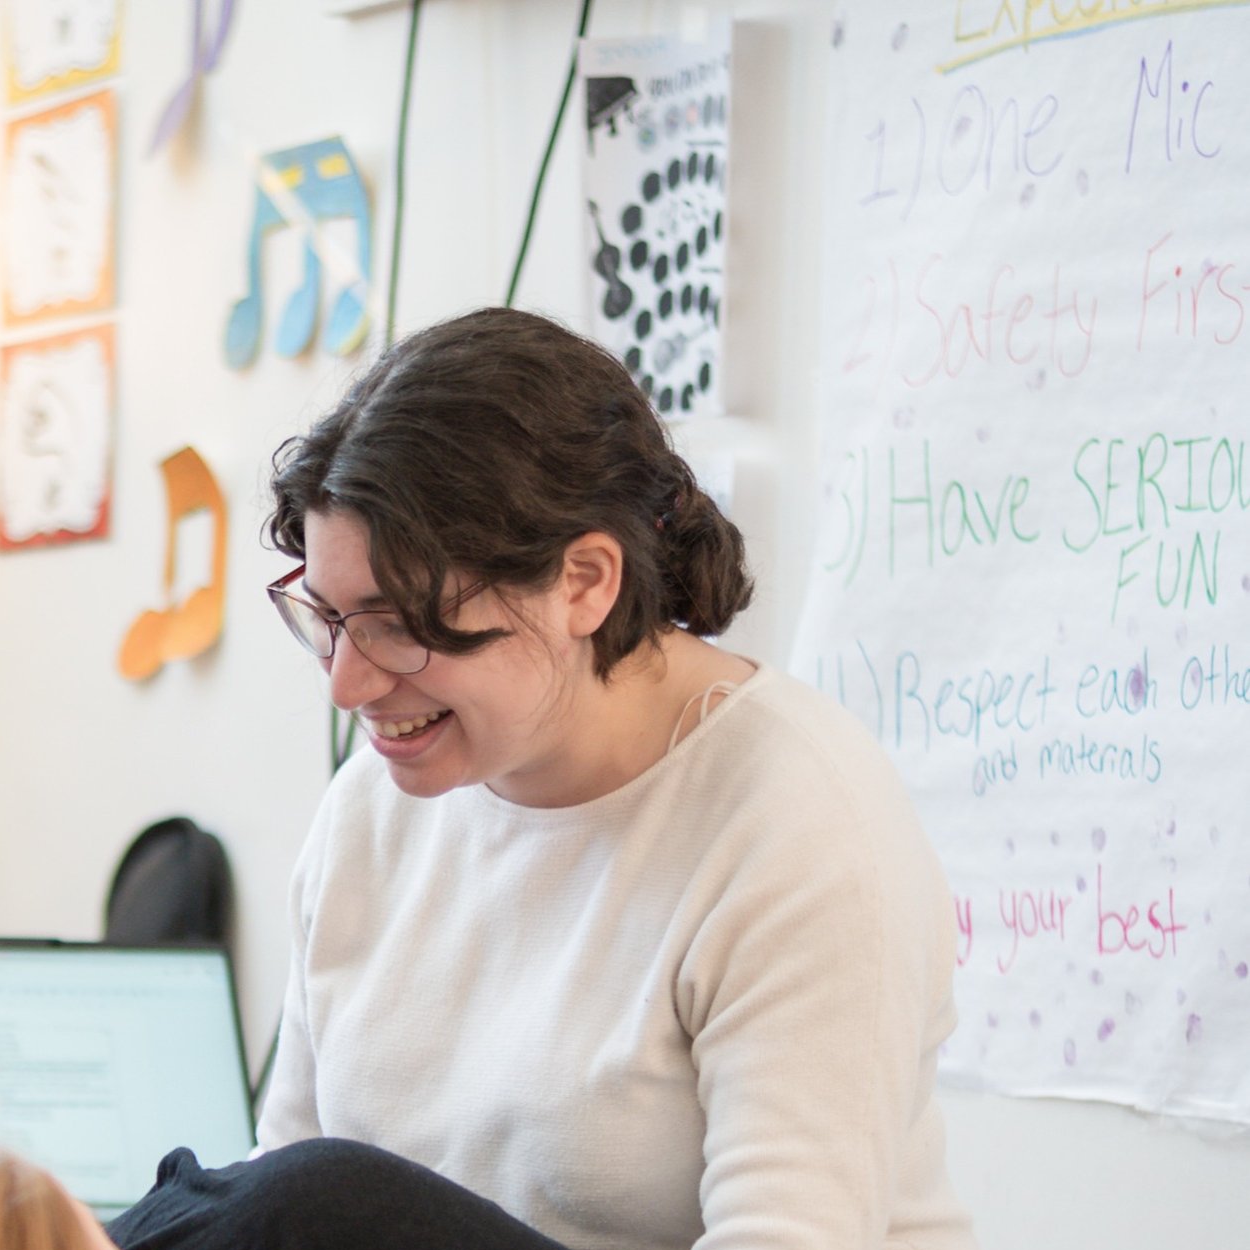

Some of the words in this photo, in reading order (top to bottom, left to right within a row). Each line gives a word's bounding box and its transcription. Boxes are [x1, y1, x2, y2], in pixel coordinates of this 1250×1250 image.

[1126, 40, 1221, 173] Mic
[1137, 229, 1250, 351] Firs
[1112, 531, 1220, 623] FUN
[1076, 646, 1158, 718] each
[973, 740, 1019, 796] and
[1040, 733, 1162, 783] materials
[997, 888, 1072, 975] your
[1098, 863, 1187, 959] best
